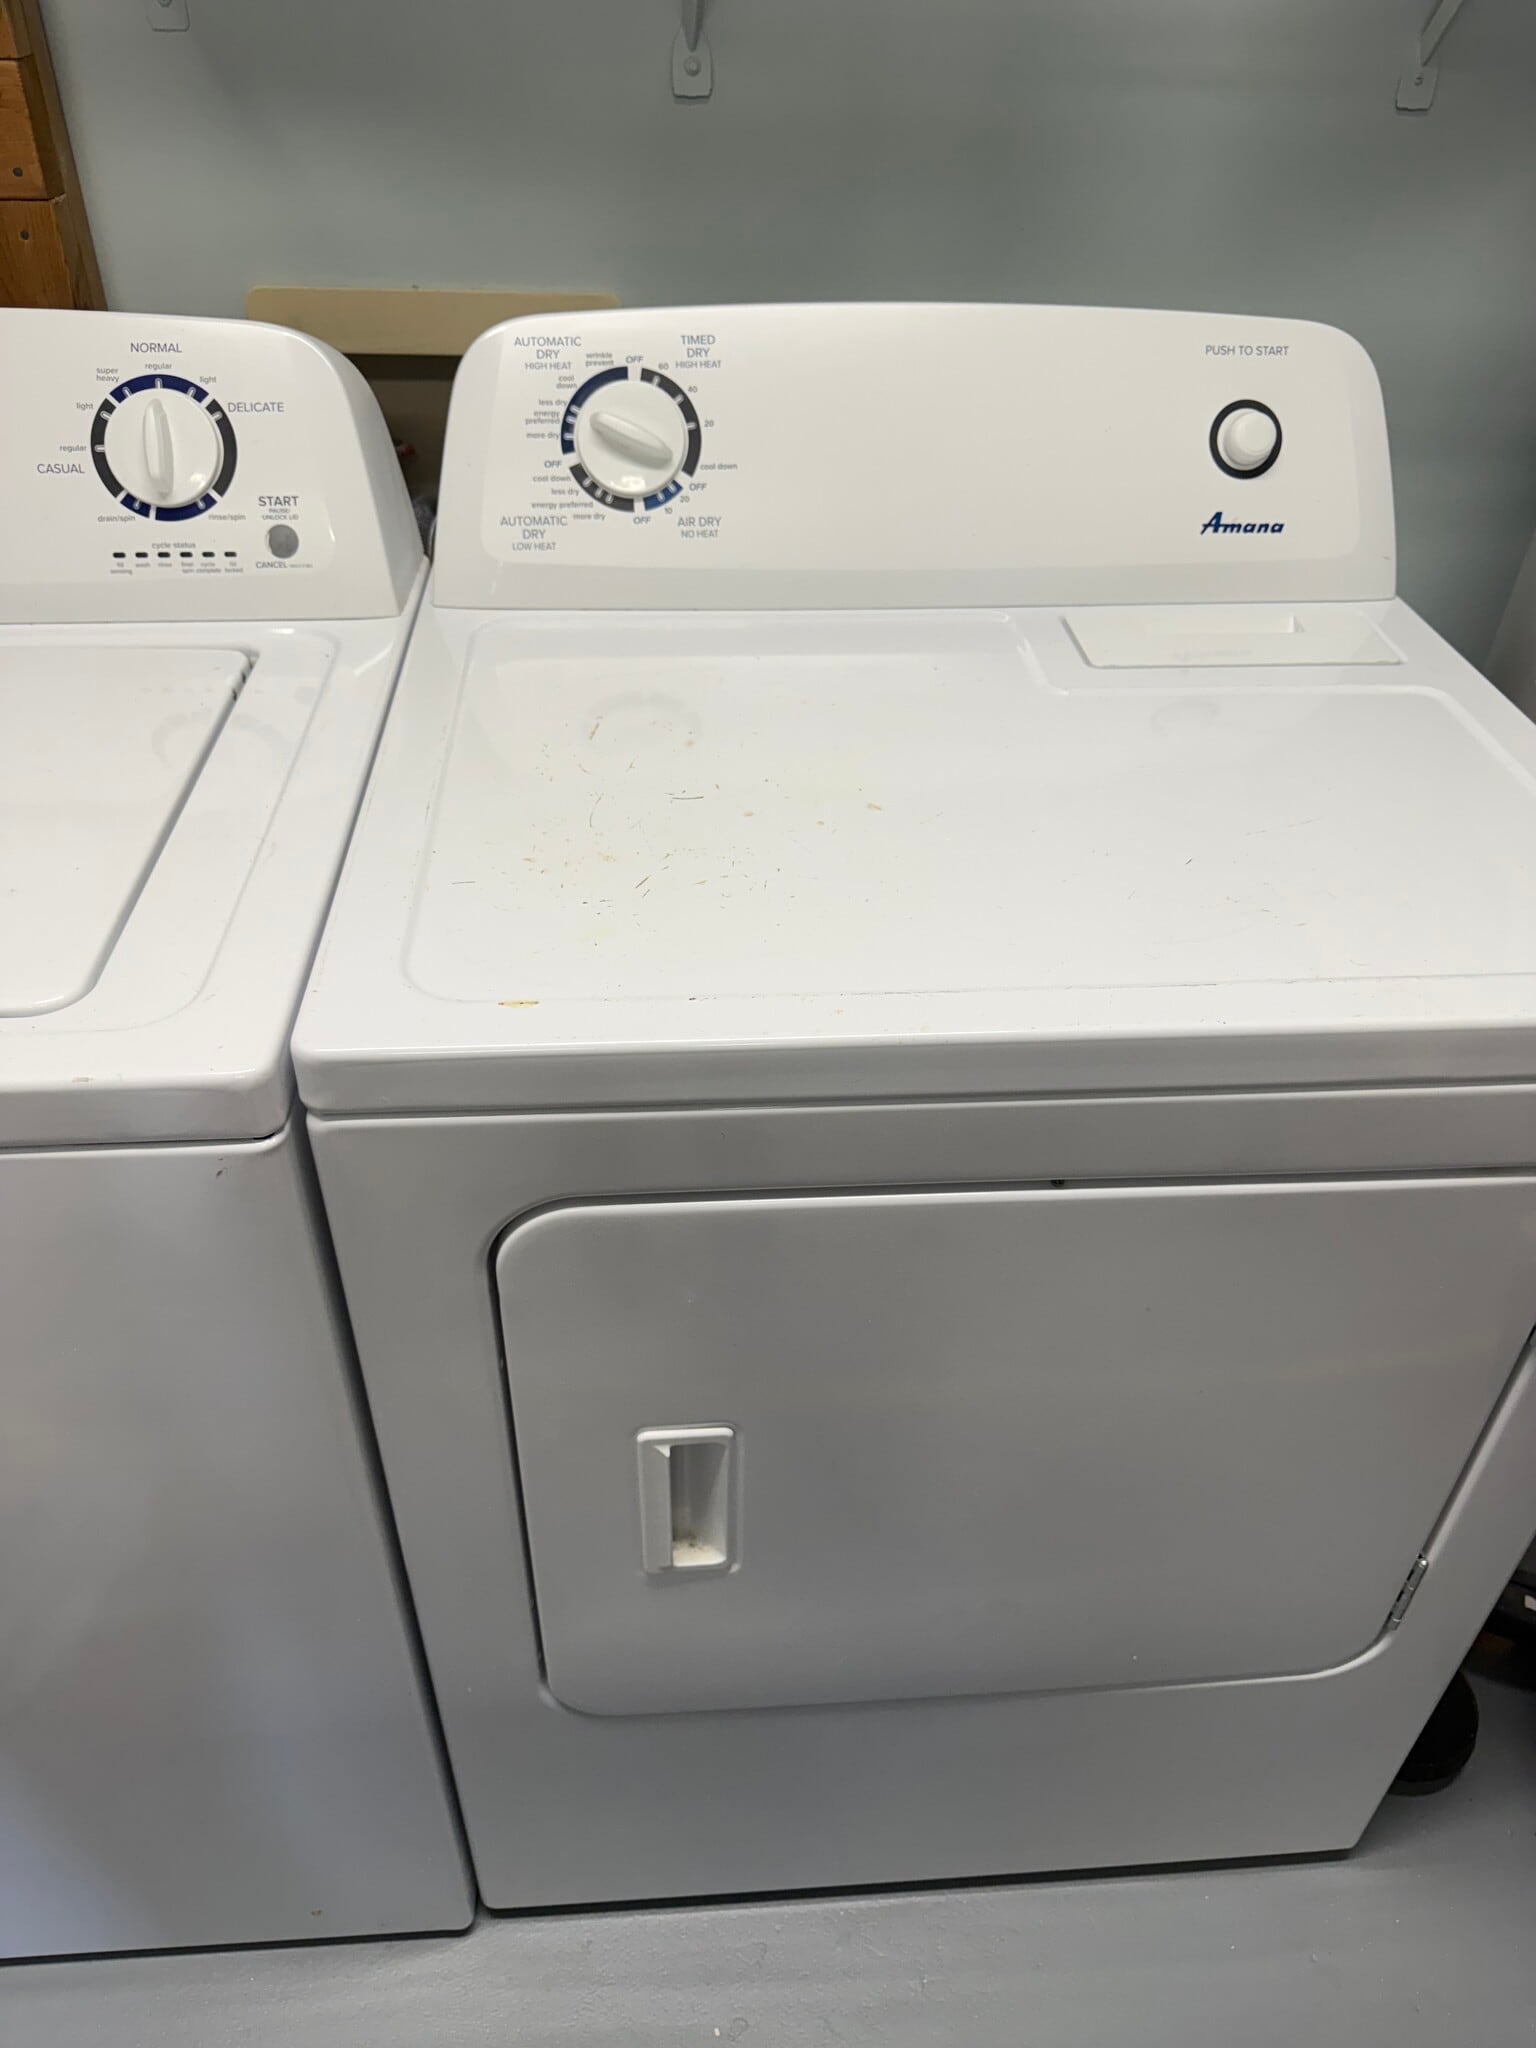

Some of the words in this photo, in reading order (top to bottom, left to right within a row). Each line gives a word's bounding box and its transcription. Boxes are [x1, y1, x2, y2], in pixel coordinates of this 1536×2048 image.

[514, 336, 582, 347] AUTOMATIC
[681, 334, 716, 345] TIMED
[130, 342, 183, 353] NORMAL
[1205, 345, 1235, 356] PUSH
[1238, 345, 1253, 356] TO
[1256, 345, 1289, 356] START
[536, 349, 560, 360] DRY
[687, 348, 710, 358] DRY
[625, 355, 644, 364] OFF
[145, 362, 172, 371] regular
[525, 362, 547, 370] HIGH
[549, 362, 572, 370] HEAT
[658, 362, 669, 370] 60
[675, 360, 698, 369] HIGH
[700, 360, 722, 369] HEAT
[96, 368, 118, 376] super
[199, 376, 217, 384] light
[687, 385, 698, 393] 40
[76, 402, 94, 411] light
[227, 402, 284, 413] DELICATE
[555, 399, 568, 407] dry
[704, 420, 714, 428] 20
[547, 432, 559, 440] dry
[59, 444, 87, 453] regular
[37, 463, 85, 474] CASUAL
[544, 460, 561, 468] OFF
[689, 483, 707, 491] OFF
[567, 488, 580, 496] dry
[258, 495, 299, 507] START
[531, 501, 557, 510] energy
[97, 514, 136, 523] drain/spin
[208, 512, 246, 521] rinse/spin
[593, 514, 606, 522] dry
[633, 516, 651, 525] OFF
[500, 516, 568, 527] AUTOMATIC
[677, 517, 696, 527] AIR
[698, 517, 722, 527] DRY
[1200, 511, 1285, 535] Amana
[522, 529, 545, 540] DRY
[681, 530, 695, 538] NO
[697, 530, 718, 538] HEAT
[151, 542, 171, 550] cycle
[512, 542, 532, 551] LOW
[534, 542, 556, 551] HEAT
[255, 561, 288, 569] CANCEL
